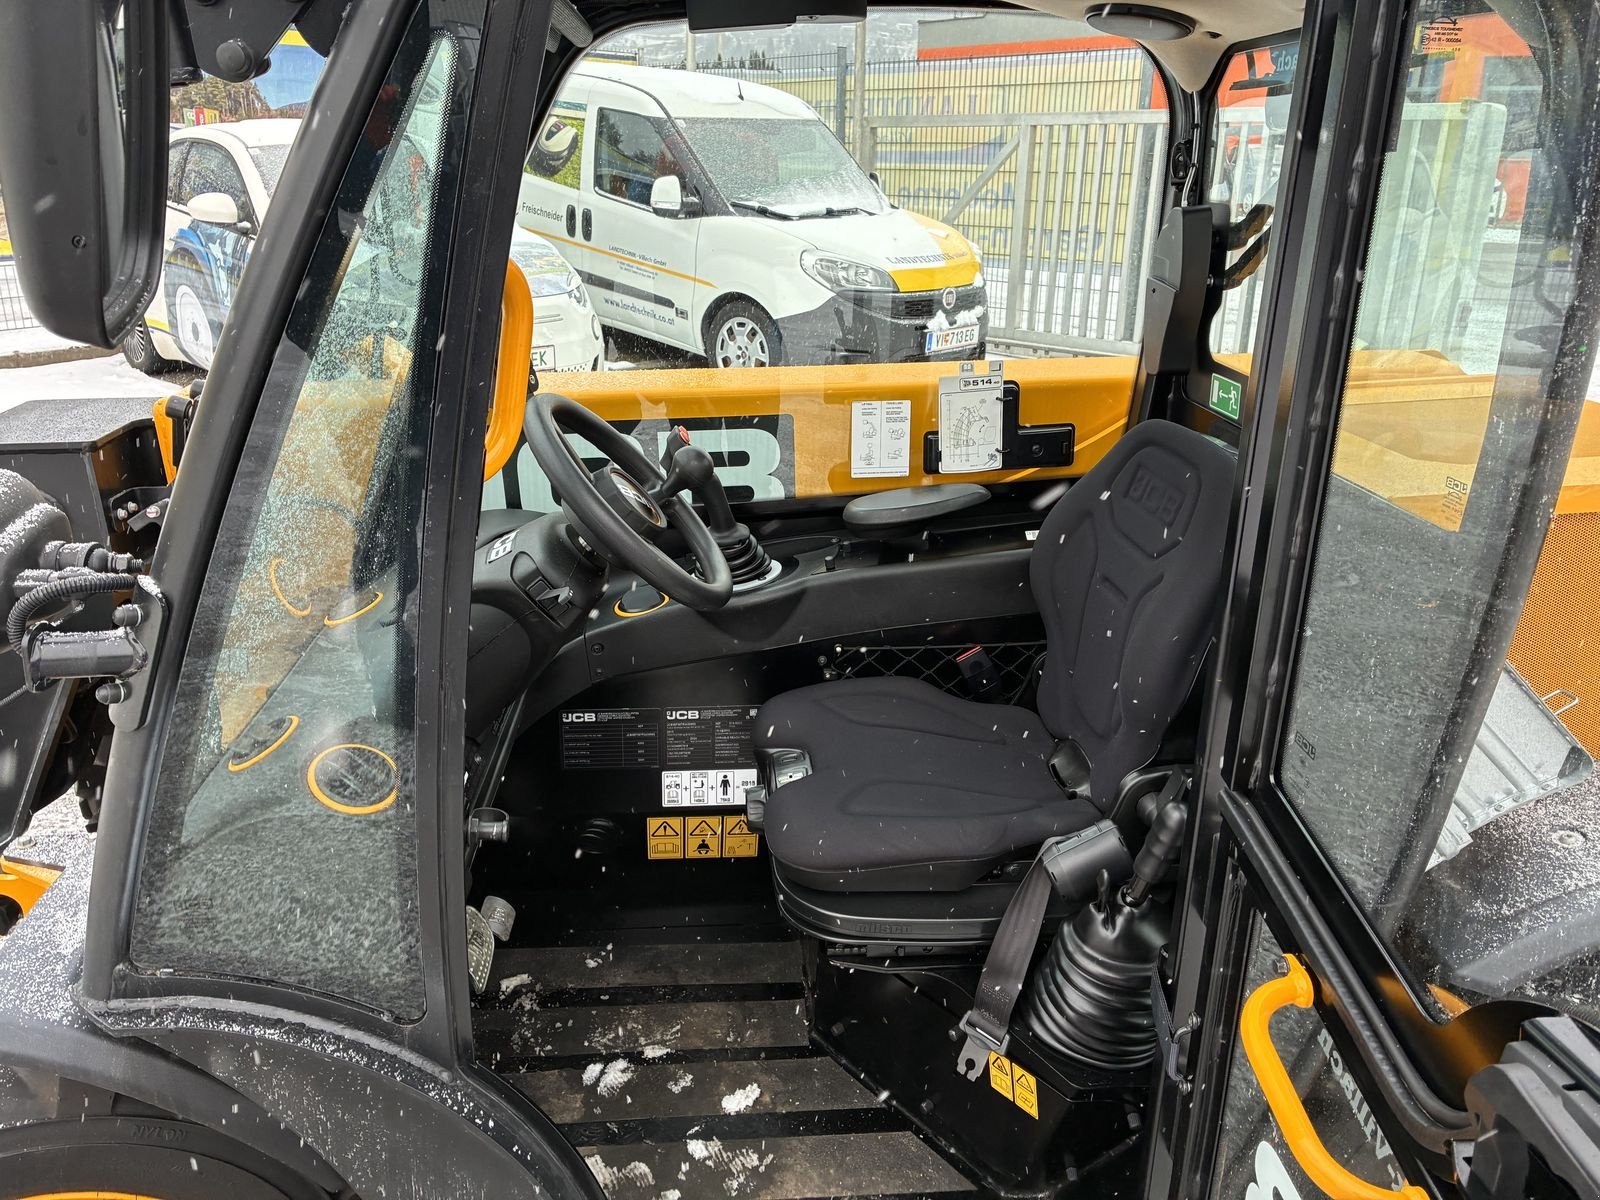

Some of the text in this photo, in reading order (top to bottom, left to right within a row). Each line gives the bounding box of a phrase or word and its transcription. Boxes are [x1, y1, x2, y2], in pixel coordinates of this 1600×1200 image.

[522, 202, 563, 222] Freischneider
[1123, 465, 1187, 528] JCB
[563, 713, 597, 722] JCB
[666, 710, 700, 720] JCB
